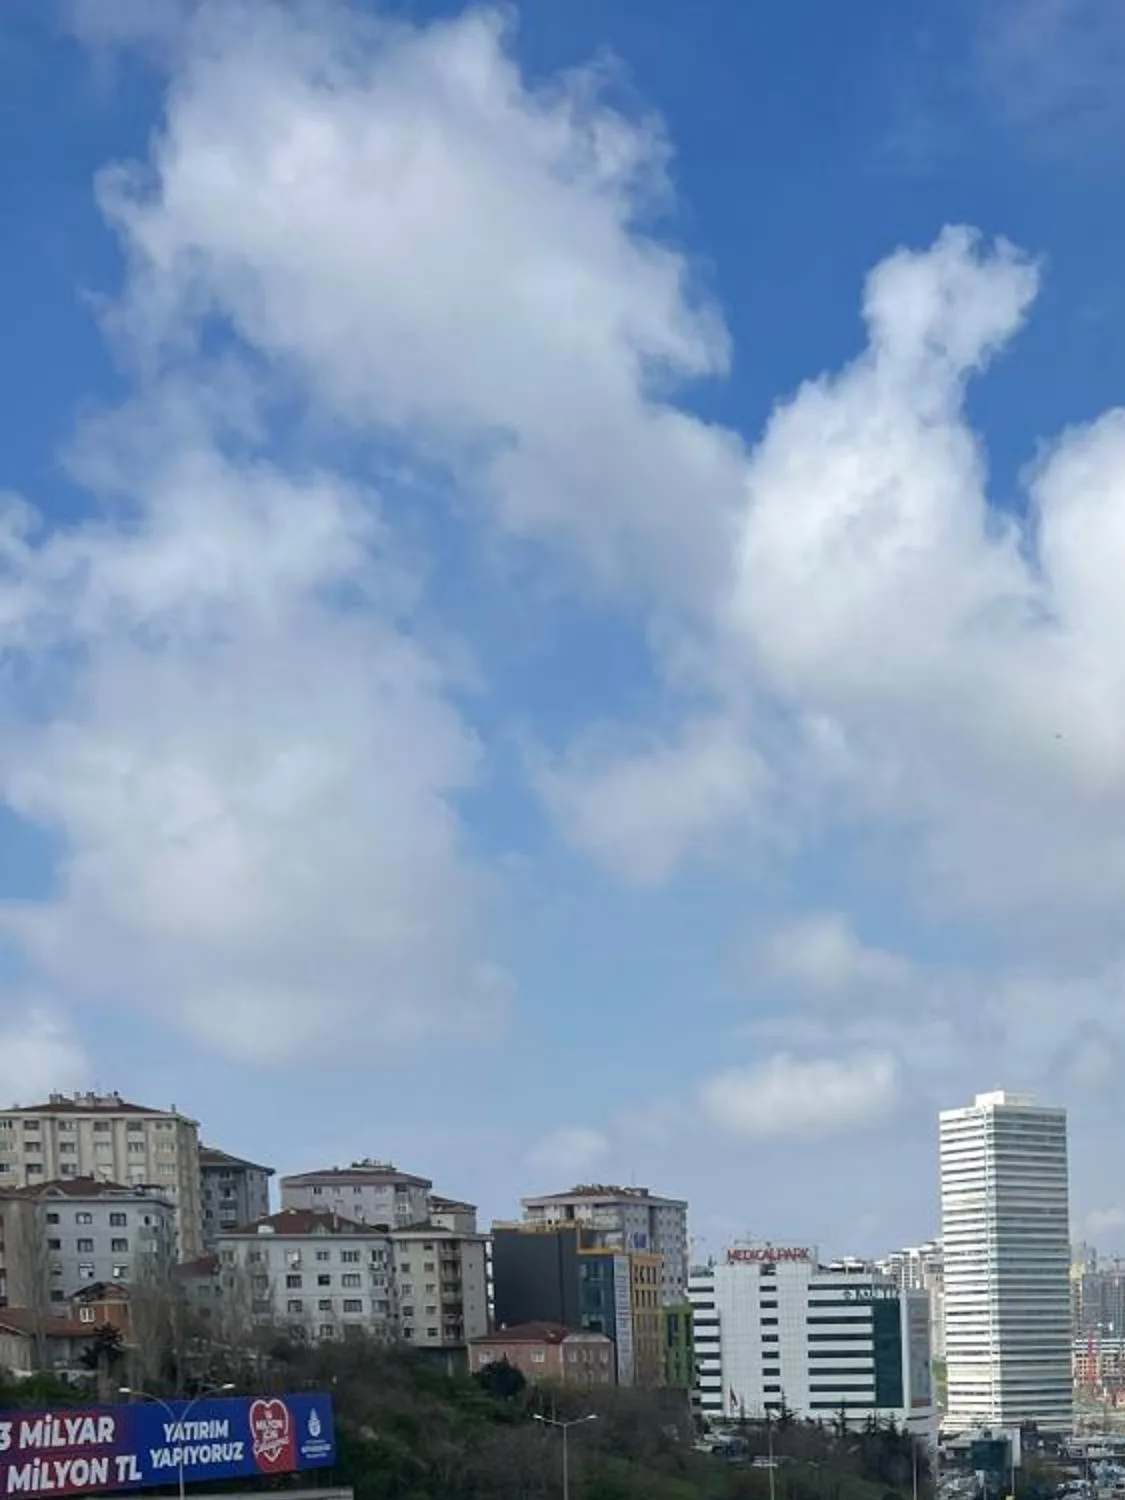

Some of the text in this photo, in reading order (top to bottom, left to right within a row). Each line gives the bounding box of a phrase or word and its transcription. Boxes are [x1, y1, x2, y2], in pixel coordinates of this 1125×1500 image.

[19, 1413, 115, 1449] MİLYAR
[163, 1419, 229, 1443] YATIRIM
[149, 1441, 245, 1469] YAPIYORUZ
[7, 1453, 143, 1493] MİLYON TL
